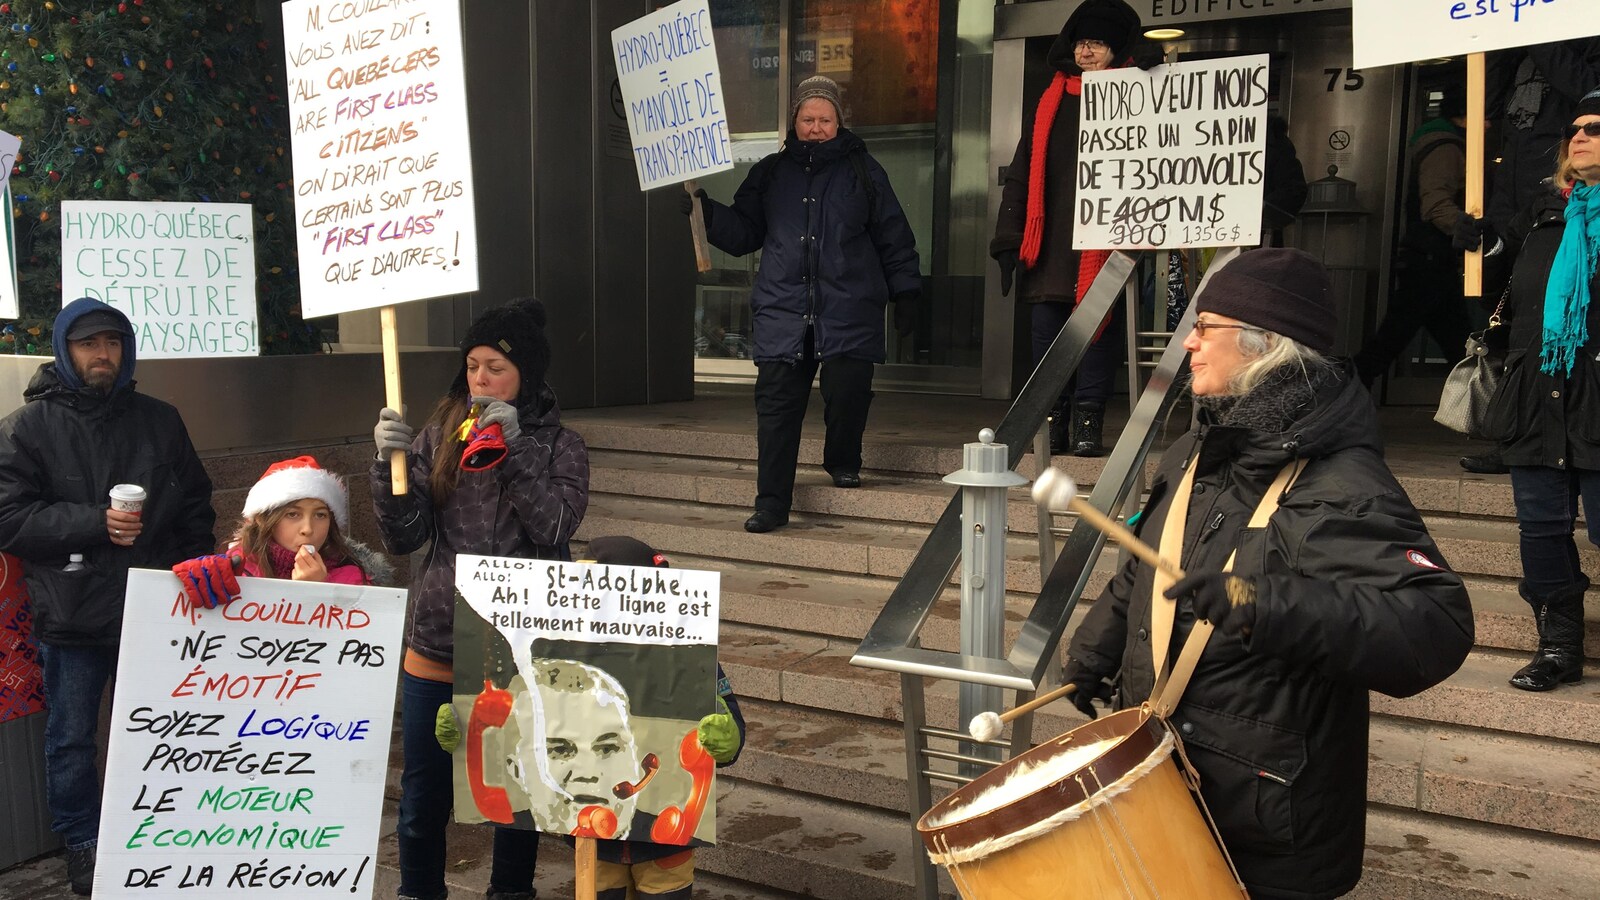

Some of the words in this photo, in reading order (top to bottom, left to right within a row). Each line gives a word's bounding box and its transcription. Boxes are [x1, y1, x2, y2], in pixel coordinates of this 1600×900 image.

[307, 5, 323, 32] M.
[289, 42, 334, 67] VOUS
[342, 29, 384, 54] AVEZ
[617, 9, 711, 75] HYDRO-QUÉBEC
[1084, 80, 1145, 121] HYDRO
[1150, 71, 1208, 114] VEUT
[1214, 65, 1268, 110] NOUS
[1324, 68, 1364, 92] 75
[295, 107, 327, 135] ARE
[335, 93, 381, 124] FIRST
[384, 82, 438, 109] CLASS
[631, 82, 691, 136] MANQUE
[695, 72, 719, 119] DE
[1079, 126, 1148, 153] PASSER
[1158, 123, 1180, 148] UN
[1195, 115, 1257, 146] SAPIN
[634, 120, 731, 184] TRANSPARENCE
[298, 168, 328, 196] ON
[331, 156, 397, 191] DIRAIT
[399, 152, 439, 175] QUE
[1079, 159, 1104, 190] DE
[302, 194, 373, 228] CERTAINS
[380, 187, 417, 211] SONT
[423, 180, 463, 203] PLUS
[76, 248, 189, 278] CESSEZ
[204, 247, 242, 278] DE
[325, 260, 364, 284] QUE
[171, 591, 203, 626] M.
[222, 597, 371, 630] COUILLARD
[546, 589, 601, 610] Cette
[619, 594, 666, 616] ligne
[678, 601, 712, 617] est
[490, 611, 585, 633] tellement
[589, 619, 703, 641] mauvaise...
[236, 635, 328, 667] SOYEZ
[337, 639, 385, 668] PAS
[0, 671, 24, 690] J5T
[171, 664, 322, 701] ÉMOTIF
[126, 706, 225, 739] SOYEZ
[237, 708, 371, 741] LOGIQUE
[142, 741, 316, 775] PROTÉGEZ
[132, 784, 183, 813] LE
[196, 785, 314, 815] MOTEUR
[126, 815, 345, 850] ÉCONOMIQUE
[124, 864, 172, 889] DE
[178, 864, 214, 889] LA
